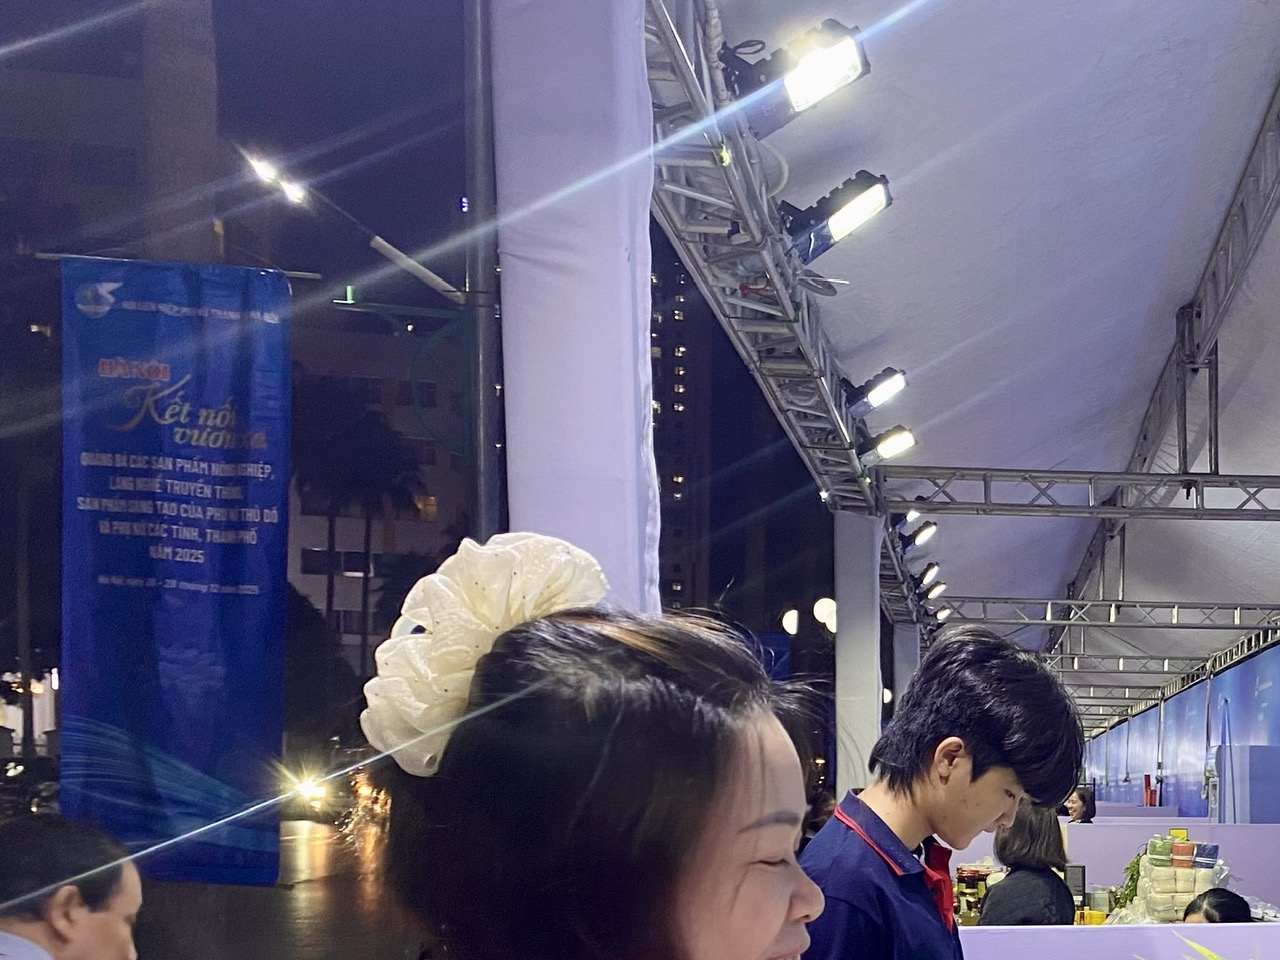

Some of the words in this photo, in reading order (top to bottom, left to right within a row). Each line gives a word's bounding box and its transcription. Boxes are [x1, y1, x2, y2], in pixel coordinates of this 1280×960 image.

[166, 479, 212, 498] TRUYỀN
[155, 501, 178, 520] TẠO
[180, 502, 203, 519] CỦA
[174, 548, 204, 564] 2025
